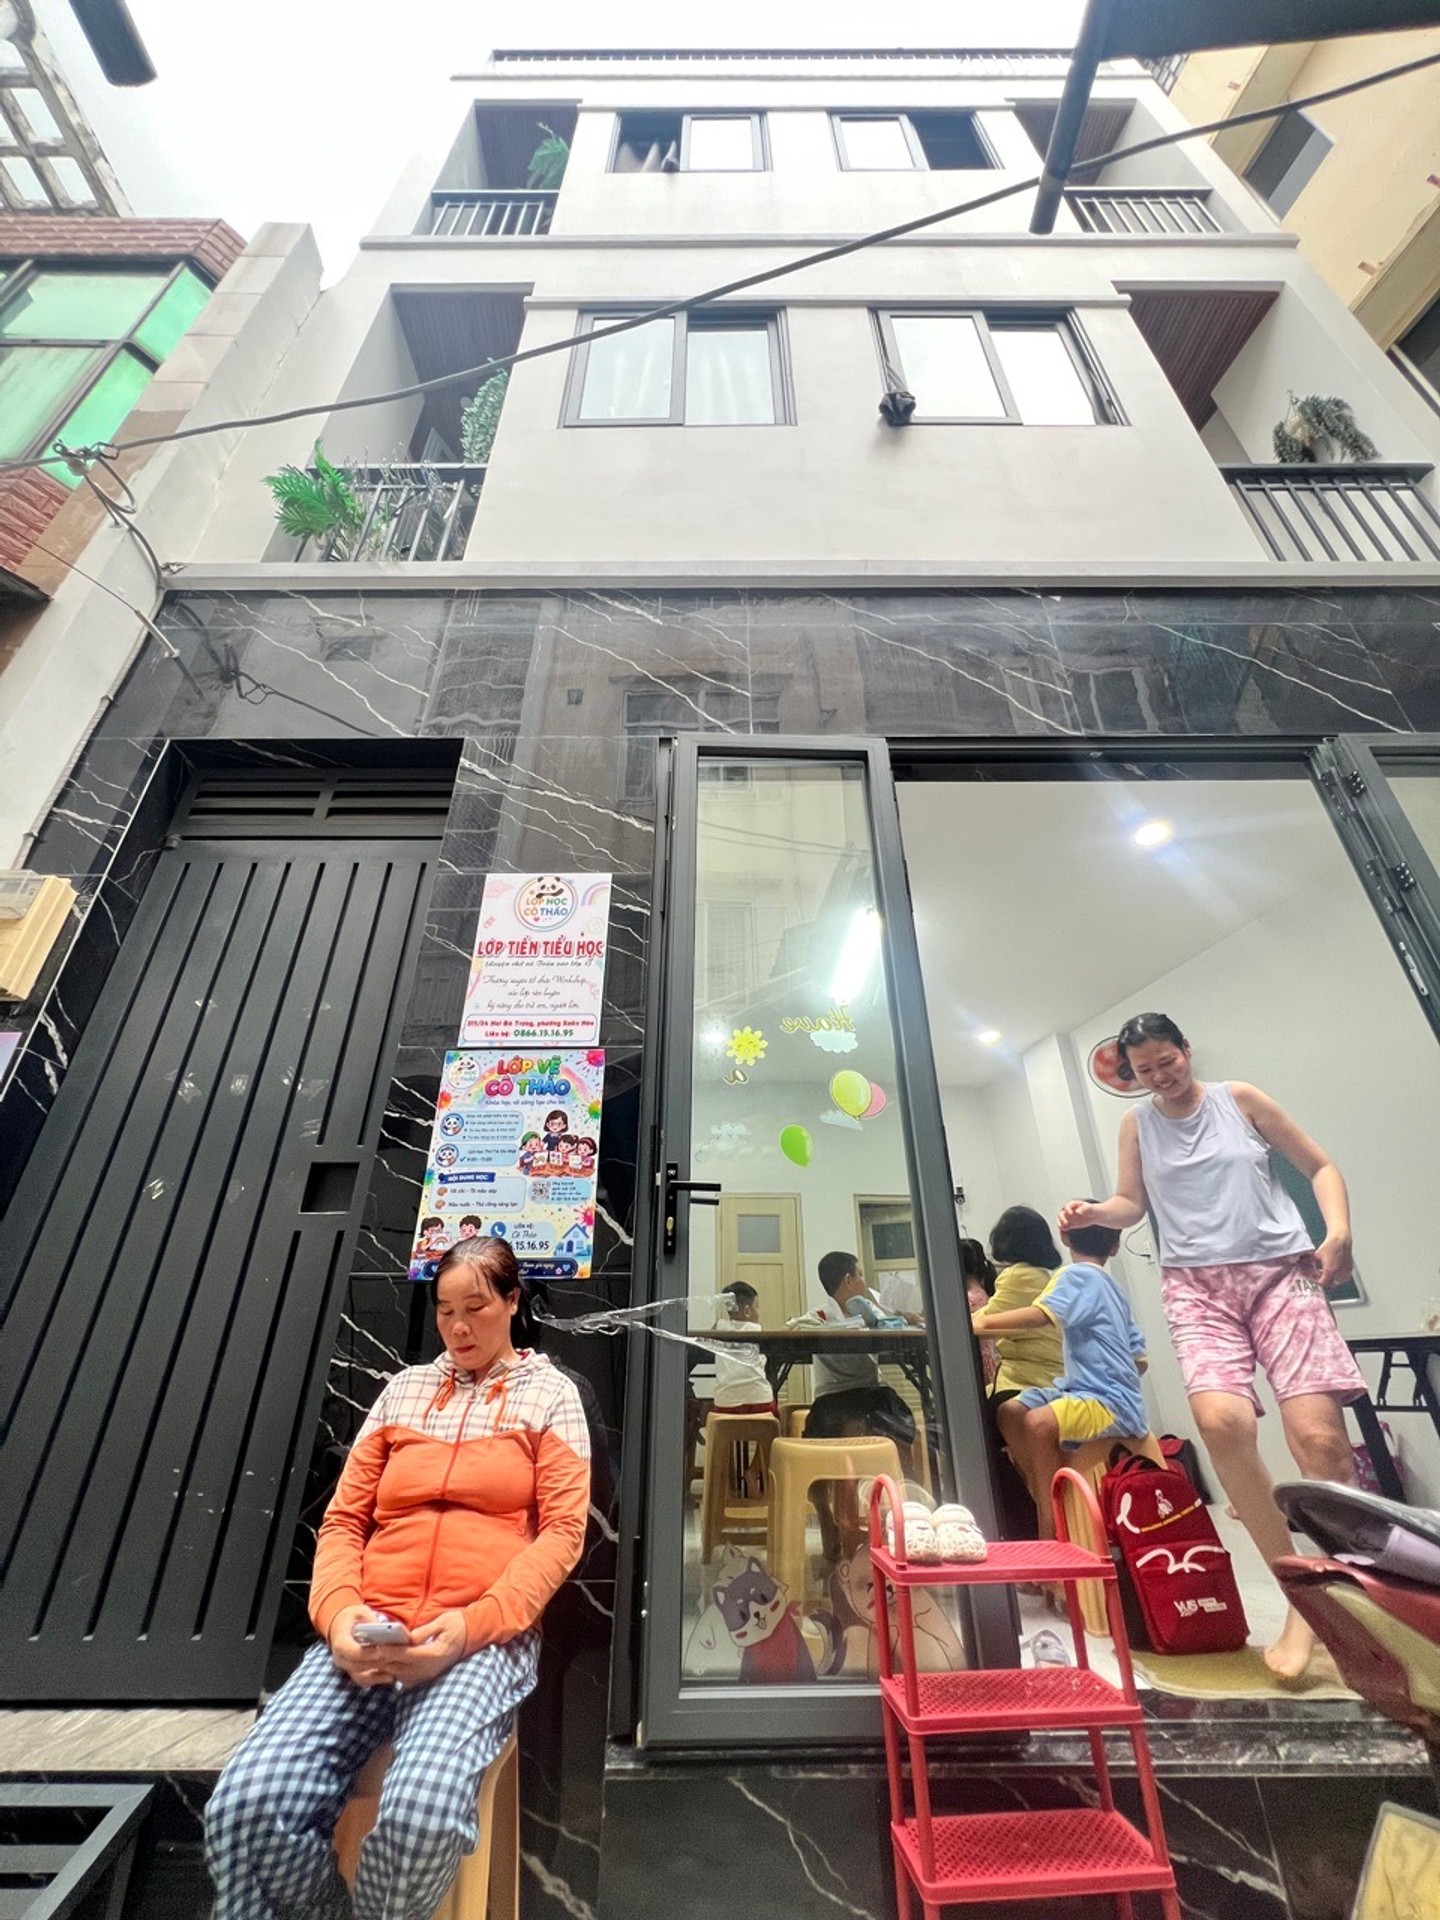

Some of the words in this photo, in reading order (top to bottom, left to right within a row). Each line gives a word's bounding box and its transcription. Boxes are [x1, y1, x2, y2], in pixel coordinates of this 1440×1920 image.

[477, 938, 504, 956] LỚP
[576, 940, 604, 960] HỌC
[513, 1029, 574, 1038] 0866.15.16.95
[497, 1055, 534, 1075] LỚP
[485, 1076, 514, 1096] CÔ
[517, 1075, 571, 1096] THẢO
